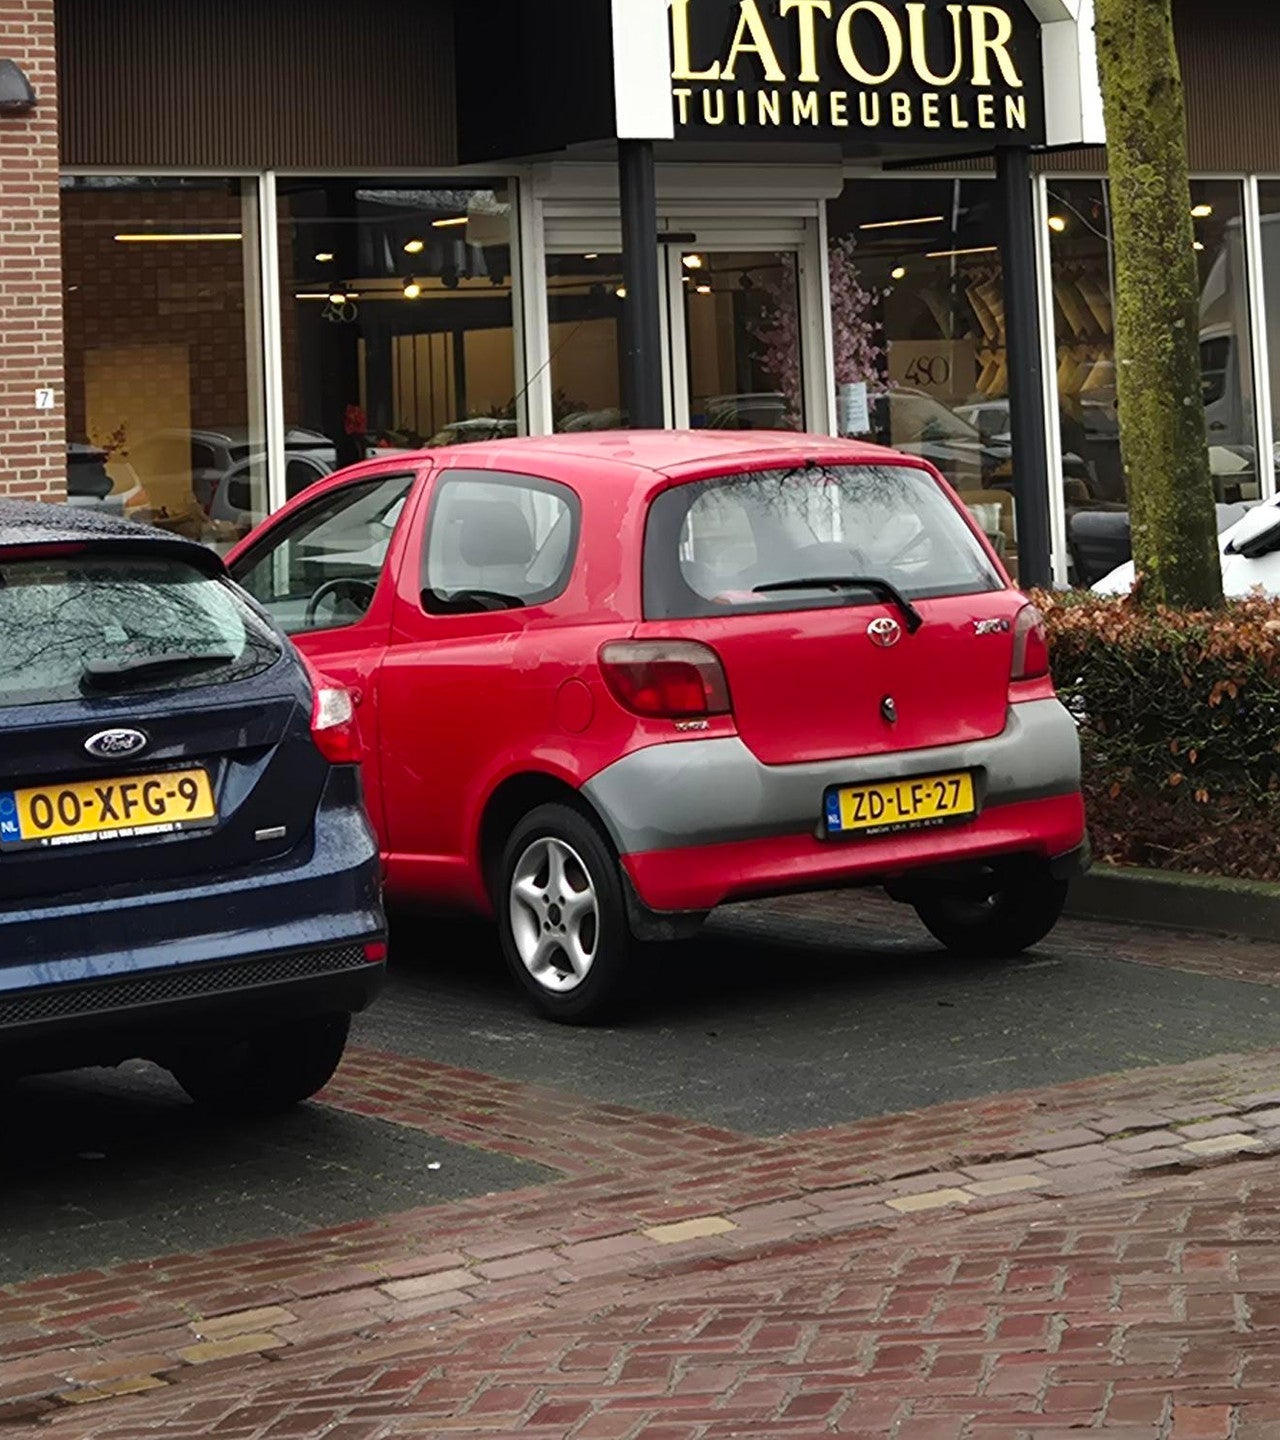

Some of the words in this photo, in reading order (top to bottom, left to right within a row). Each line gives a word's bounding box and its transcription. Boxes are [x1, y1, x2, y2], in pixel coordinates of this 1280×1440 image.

[673, 88, 1026, 129] TUINMEUBELEN
[40, 391, 49, 407] 7
[101, 733, 134, 751] Ford
[1, 820, 18, 833] NL
[30, 777, 199, 830] 00-XFG-9
[851, 779, 961, 822] ZD-LF-27
